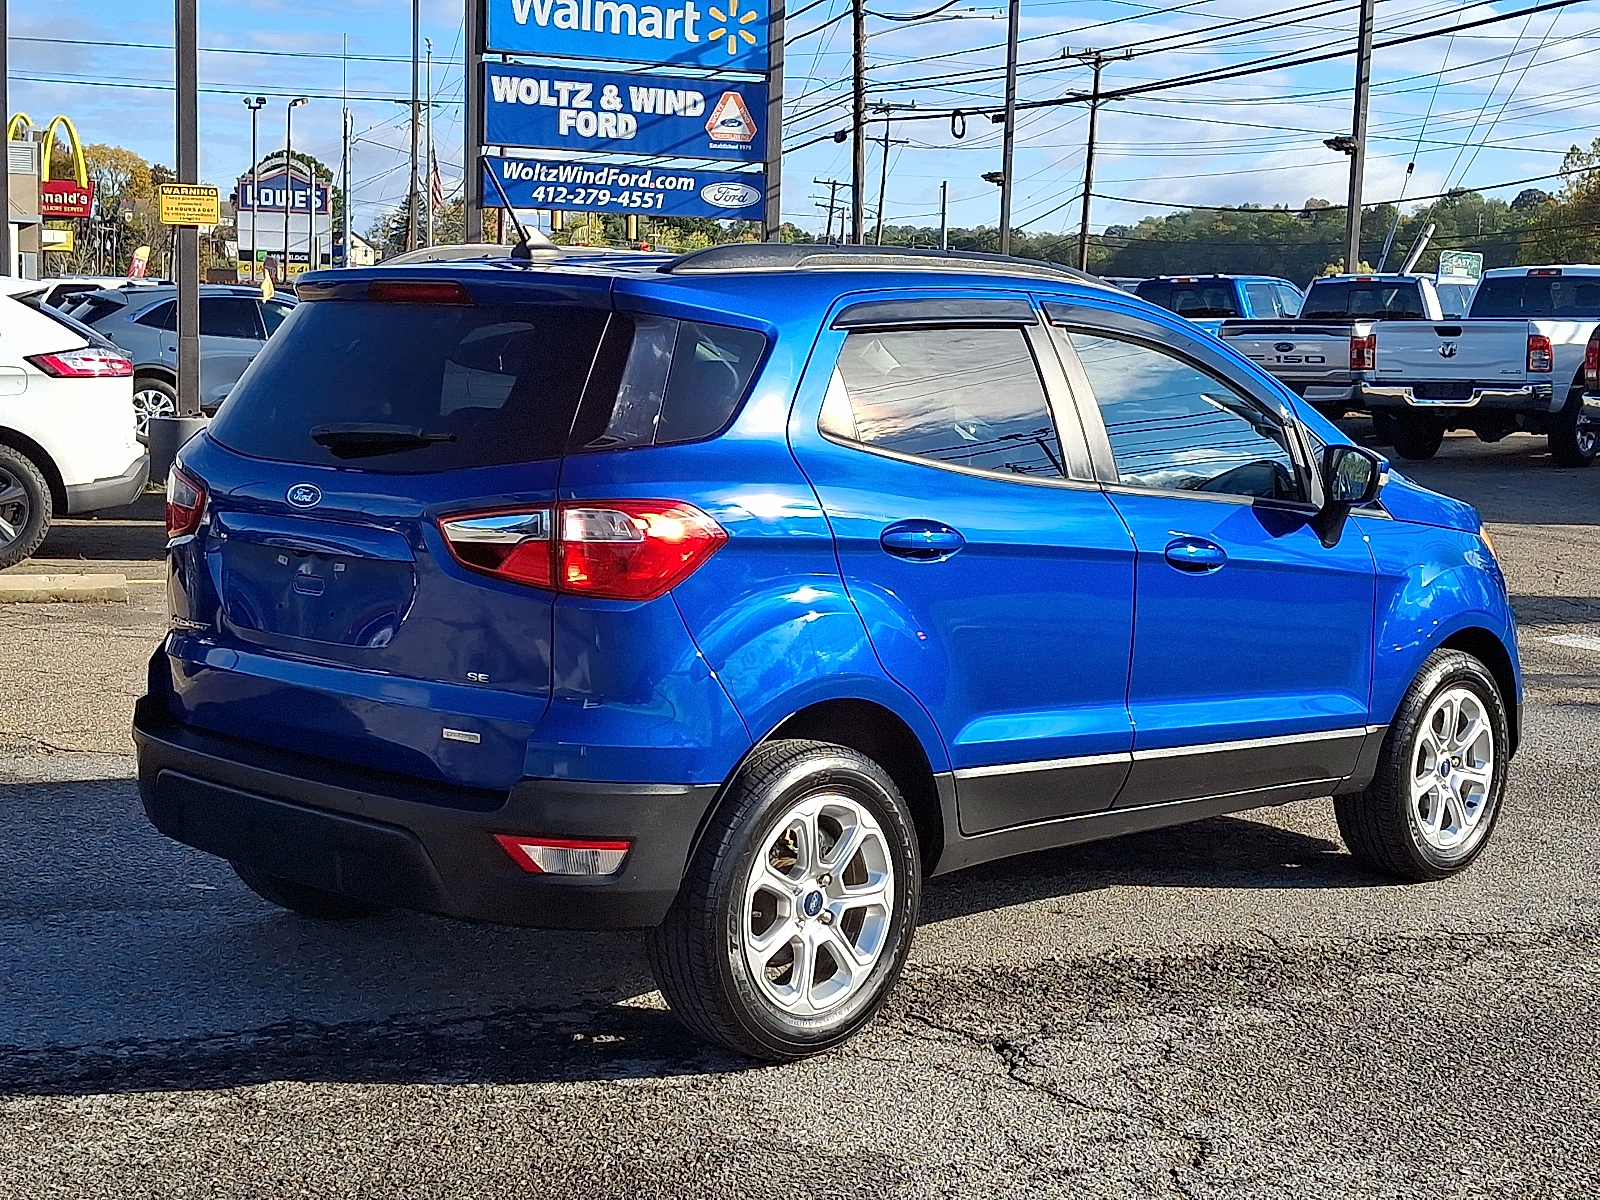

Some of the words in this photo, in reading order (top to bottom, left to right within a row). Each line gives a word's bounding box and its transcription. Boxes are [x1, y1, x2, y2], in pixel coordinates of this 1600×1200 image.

[511, 0, 701, 42] Walmart
[491, 76, 593, 108] WOLTZ
[599, 84, 623, 111] &
[629, 87, 706, 117] WIND
[559, 109, 637, 139] FORD
[709, 142, 738, 150] Established
[503, 161, 695, 191] WoltzWindFord.com
[162, 186, 217, 196] WARNING
[532, 186, 664, 209] 412-279-4551
[713, 186, 749, 203] Ford
[467, 672, 490, 683] SE
